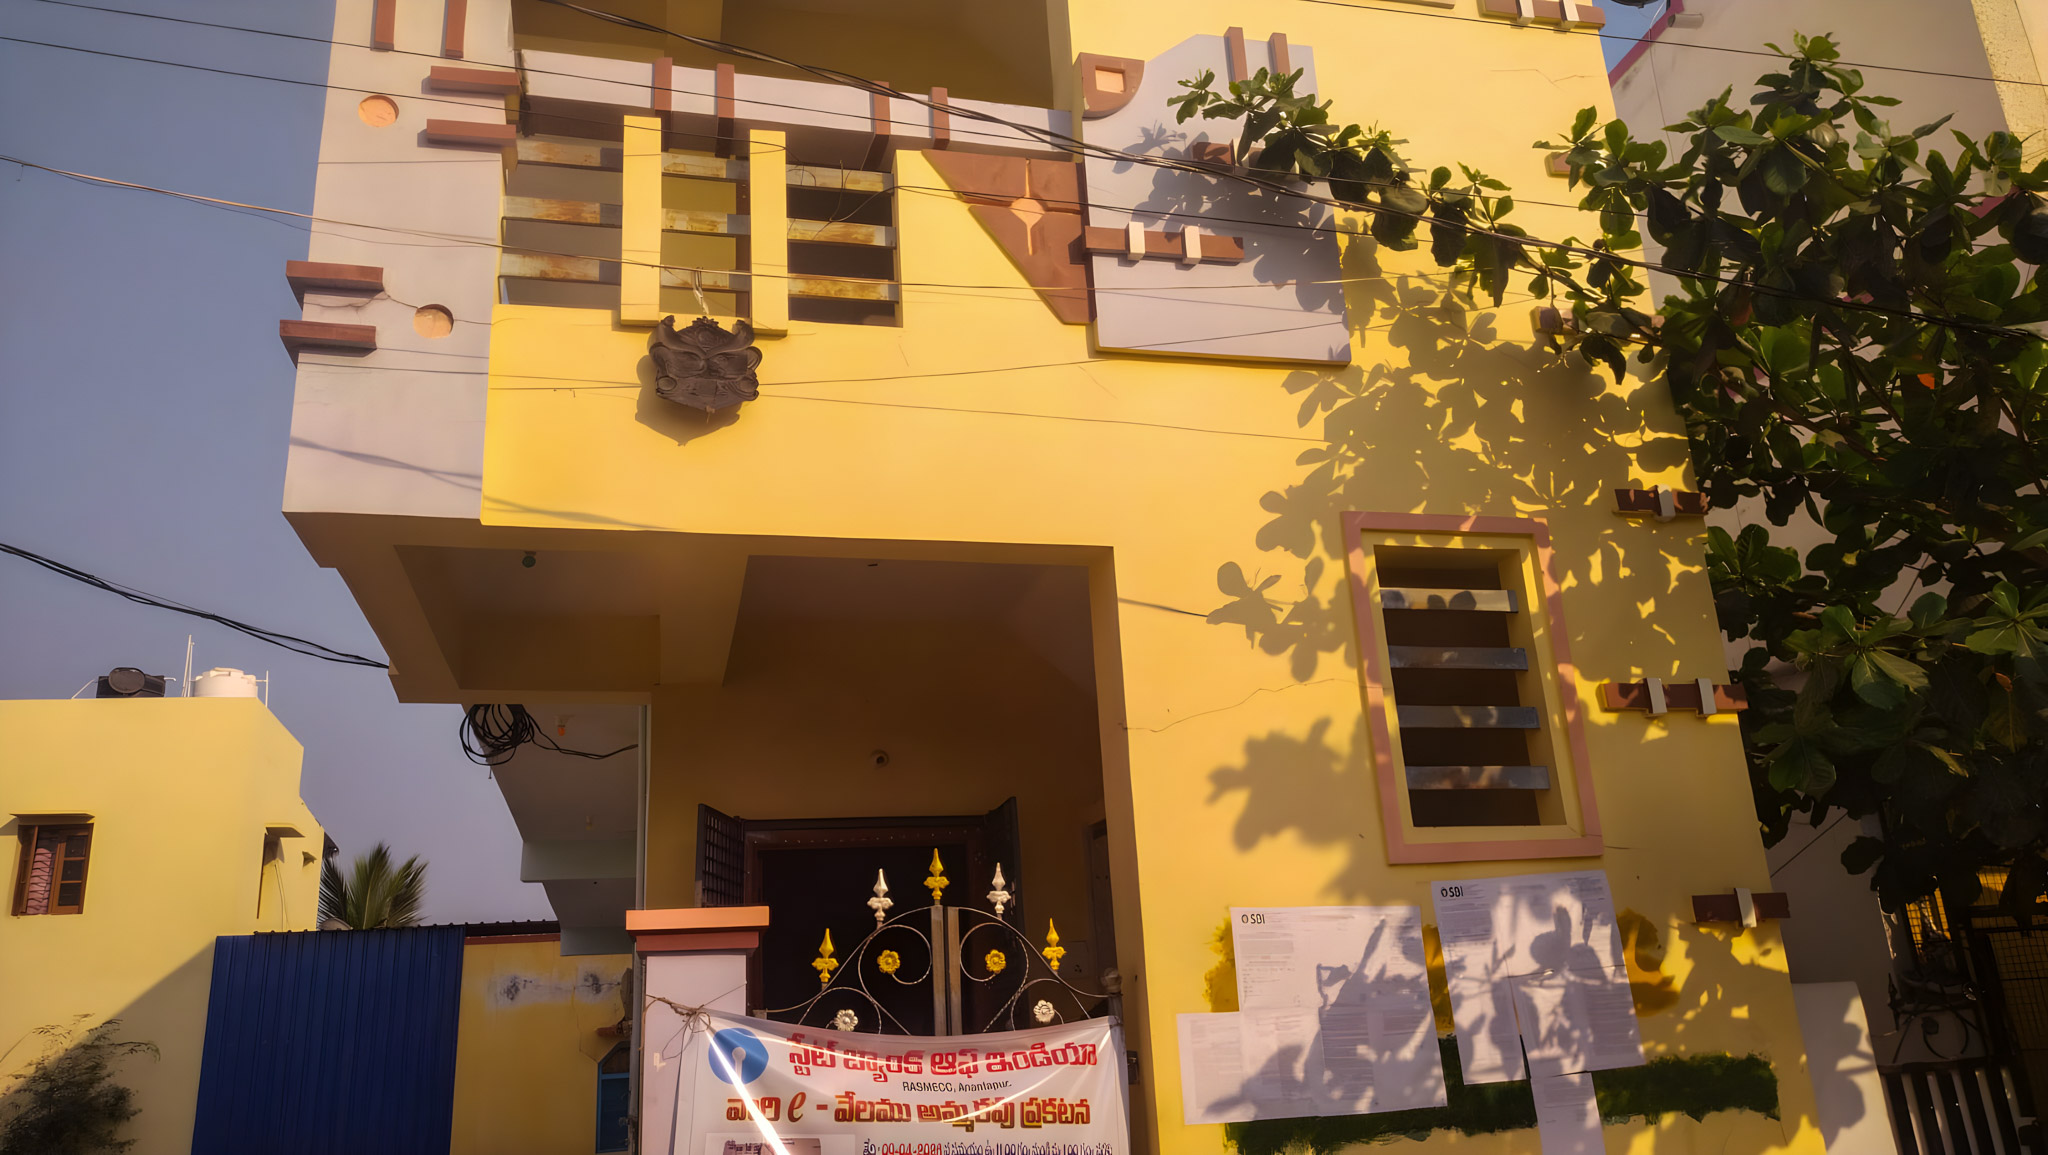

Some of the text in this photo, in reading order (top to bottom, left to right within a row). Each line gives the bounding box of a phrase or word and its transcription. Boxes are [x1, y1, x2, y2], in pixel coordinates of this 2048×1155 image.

[985, 1042, 1097, 1072] ఇండియా
[787, 1091, 807, 1123] e
[834, 1090, 912, 1123] వేలము
[1020, 1097, 1091, 1129] ప్రకటన
